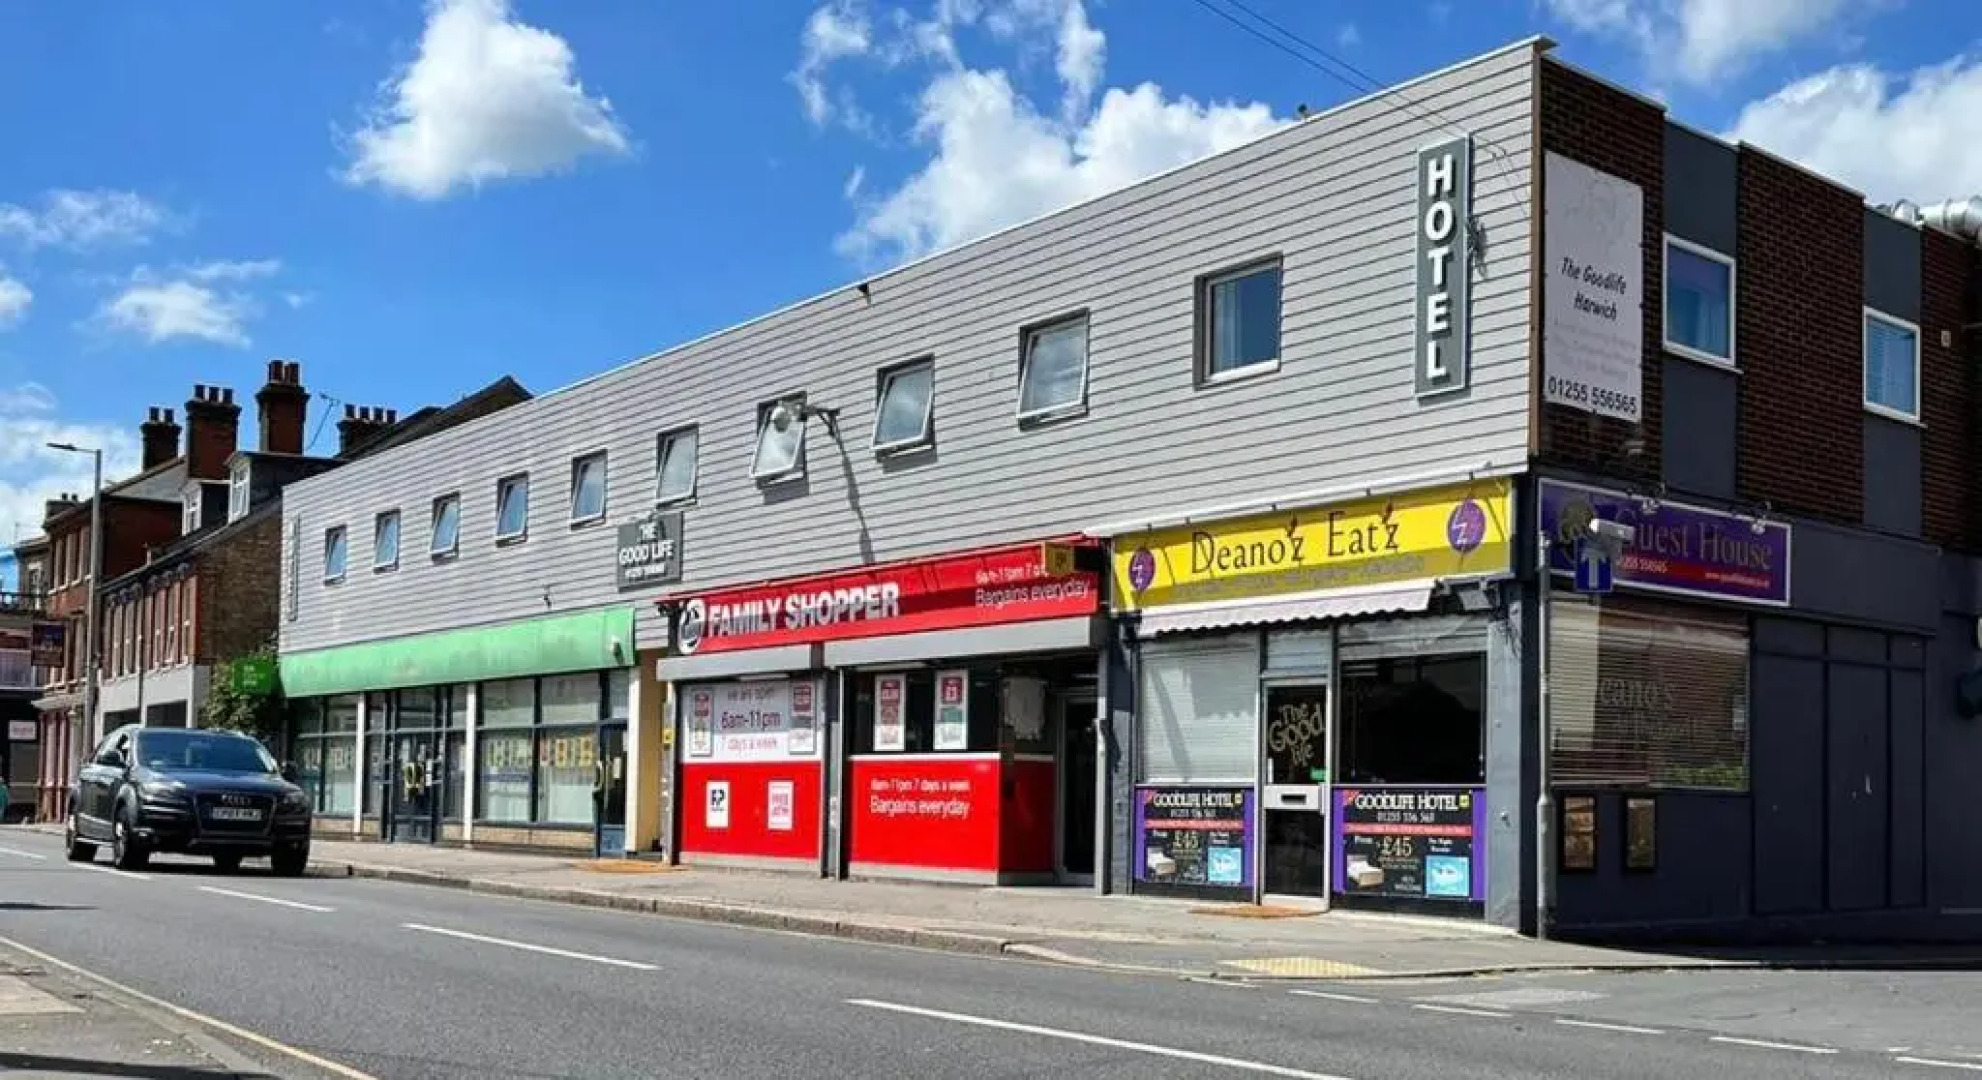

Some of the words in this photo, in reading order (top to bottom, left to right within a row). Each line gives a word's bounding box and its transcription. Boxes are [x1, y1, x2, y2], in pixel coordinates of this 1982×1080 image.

[1424, 154, 1454, 380] HOTEL
[1561, 257, 1581, 280] The
[1583, 265, 1627, 295] Goodlife
[1574, 291, 1618, 322] Harwich
[1548, 375, 1588, 404] 01255
[1592, 385, 1638, 416] 556565
[619, 545, 649, 566] GOOD
[652, 539, 675, 560] LIFE
[1700, 521, 1773, 571] House
[976, 583, 1029, 610] Bargains
[1031, 577, 1090, 602] everyday
[708, 597, 781, 638] FAMILY
[785, 582, 900, 630] SHOPPER
[722, 710, 782, 732] 6am-11pm
[1269, 701, 1322, 752] Good
[870, 794, 917, 818] Bargains
[919, 796, 971, 820] everyday
[1201, 792, 1233, 809] HOTEL
[1356, 792, 1416, 810] GOODLIFE
[1417, 792, 1459, 811] HOTEL
[1381, 836, 1413, 857] £45
